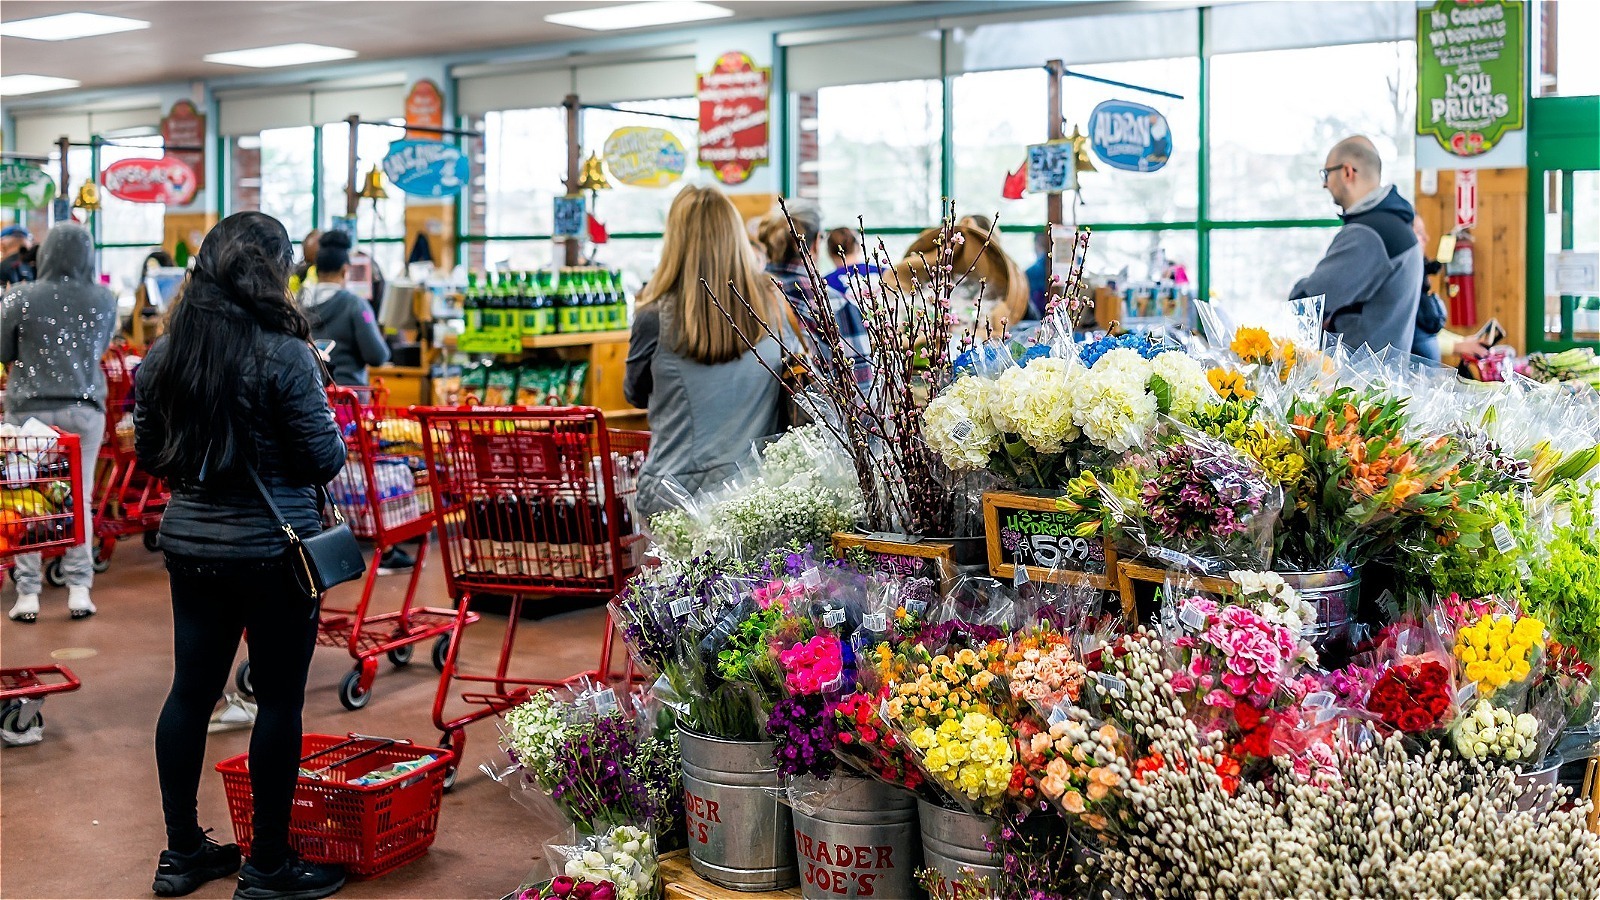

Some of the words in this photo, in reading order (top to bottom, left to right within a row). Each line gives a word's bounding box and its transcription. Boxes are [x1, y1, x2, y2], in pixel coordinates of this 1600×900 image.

[1445, 72, 1492, 97] LOW
[1431, 93, 1509, 123] PRICES
[685, 789, 722, 823] DER
[795, 828, 895, 869] TRADER
[804, 862, 878, 897] JOE'S
